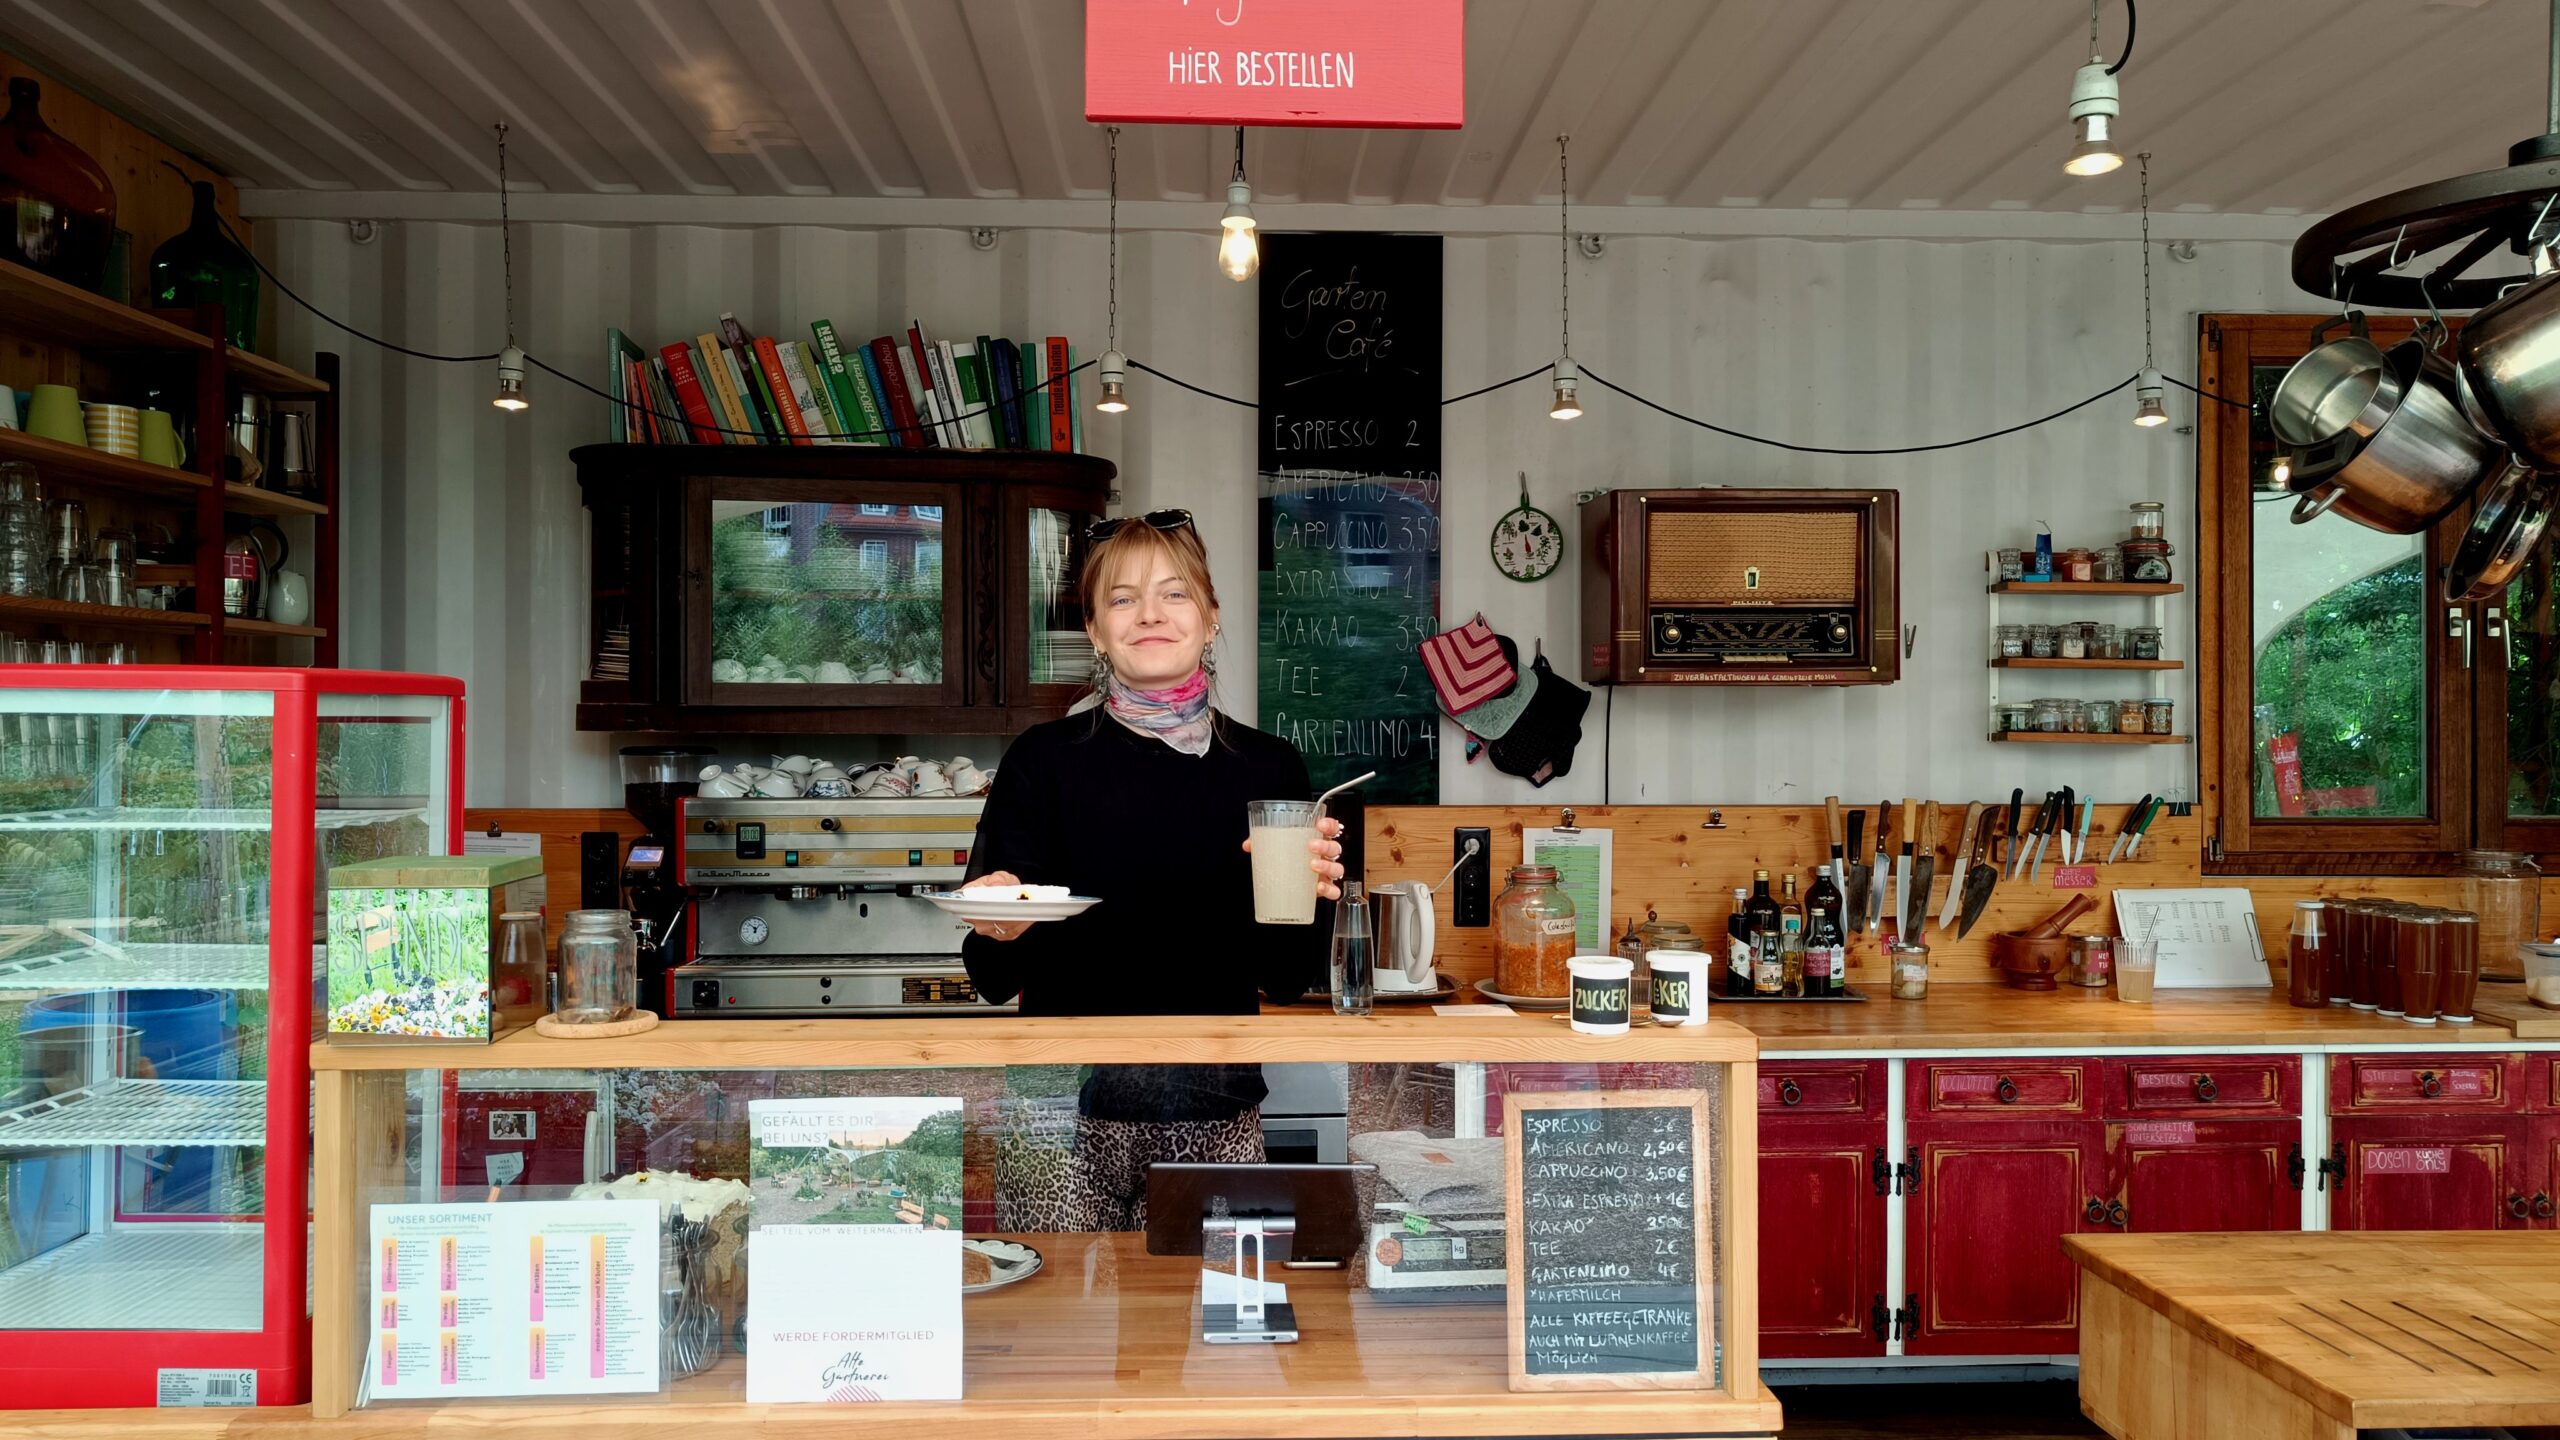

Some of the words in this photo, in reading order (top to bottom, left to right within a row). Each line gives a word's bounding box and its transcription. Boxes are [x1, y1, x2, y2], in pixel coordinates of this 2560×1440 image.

[1236, 51, 1354, 88] BESTELLEN
[1281, 265, 1387, 338] Garten
[820, 325, 844, 374] GARTEN
[1326, 317, 1394, 373] Café
[1275, 415, 1379, 450] ESPRESSO
[1405, 420, 1420, 447] 2
[1274, 464, 1388, 502] AMERICANO
[1273, 513, 1389, 550] CAPPUCCINO
[1276, 562, 1340, 598] EXTRA
[1403, 565, 1413, 598] 1
[1276, 609, 1360, 648] KAKAO
[1276, 658, 1323, 696] TEE
[1394, 665, 1408, 697] 2
[1419, 720, 1437, 760] 4
[1575, 988, 1627, 1011] ZUCKER
[2141, 1074, 2185, 1086] BESTECK
[828, 1116, 844, 1127] ES
[850, 1115, 873, 1126] DIR
[1527, 1118, 1601, 1135] ESPRESSO
[1653, 1117, 1679, 1133] 2€
[764, 1132, 786, 1143] BEI
[790, 1132, 829, 1143] UNS?
[1530, 1138, 1629, 1158] AMERICANO
[1527, 1163, 1628, 1180] CAPPUCCINO
[388, 1215, 425, 1224] UNSER
[429, 1213, 493, 1223] SORTIMENT
[783, 1227, 804, 1236] TEIL
[807, 1227, 831, 1236] VOM
[837, 1226, 923, 1236] WEITERMACHEN
[1454, 1244, 1465, 1253] kg
[1529, 1240, 1561, 1256] TEE
[1654, 1239, 1680, 1255] 2€
[1658, 1262, 1680, 1277] 4€
[1530, 1313, 1565, 1328] ALLE
[773, 1331, 821, 1342] WERDE
[1529, 1333, 1560, 1348] AUCH
